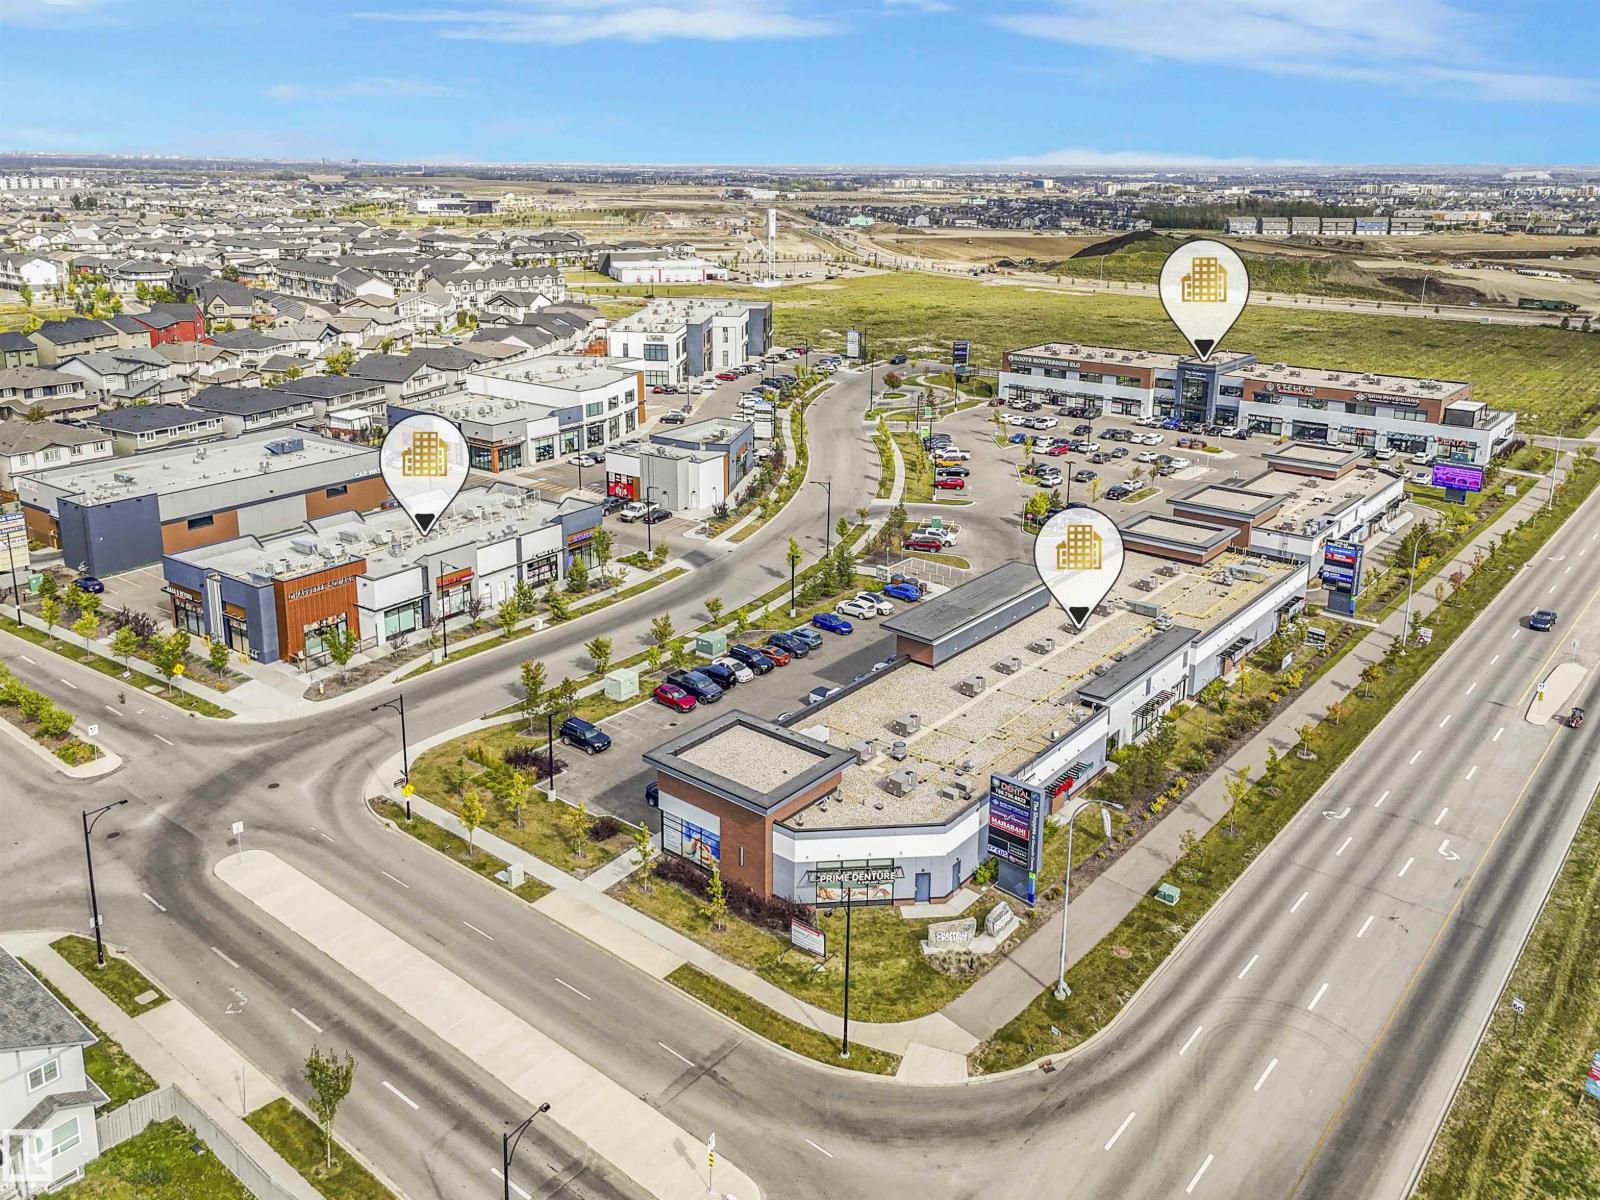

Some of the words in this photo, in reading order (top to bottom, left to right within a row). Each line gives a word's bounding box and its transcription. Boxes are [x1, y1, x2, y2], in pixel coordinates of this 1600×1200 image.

[1367, 393, 1385, 401] SKIN
[1437, 436, 1473, 448] DENTAL
[1001, 782, 1030, 799] DENTAL
[991, 817, 1026, 836] MAHARANI
[820, 874, 850, 883] PRIME
[852, 872, 896, 881] DENTURE
